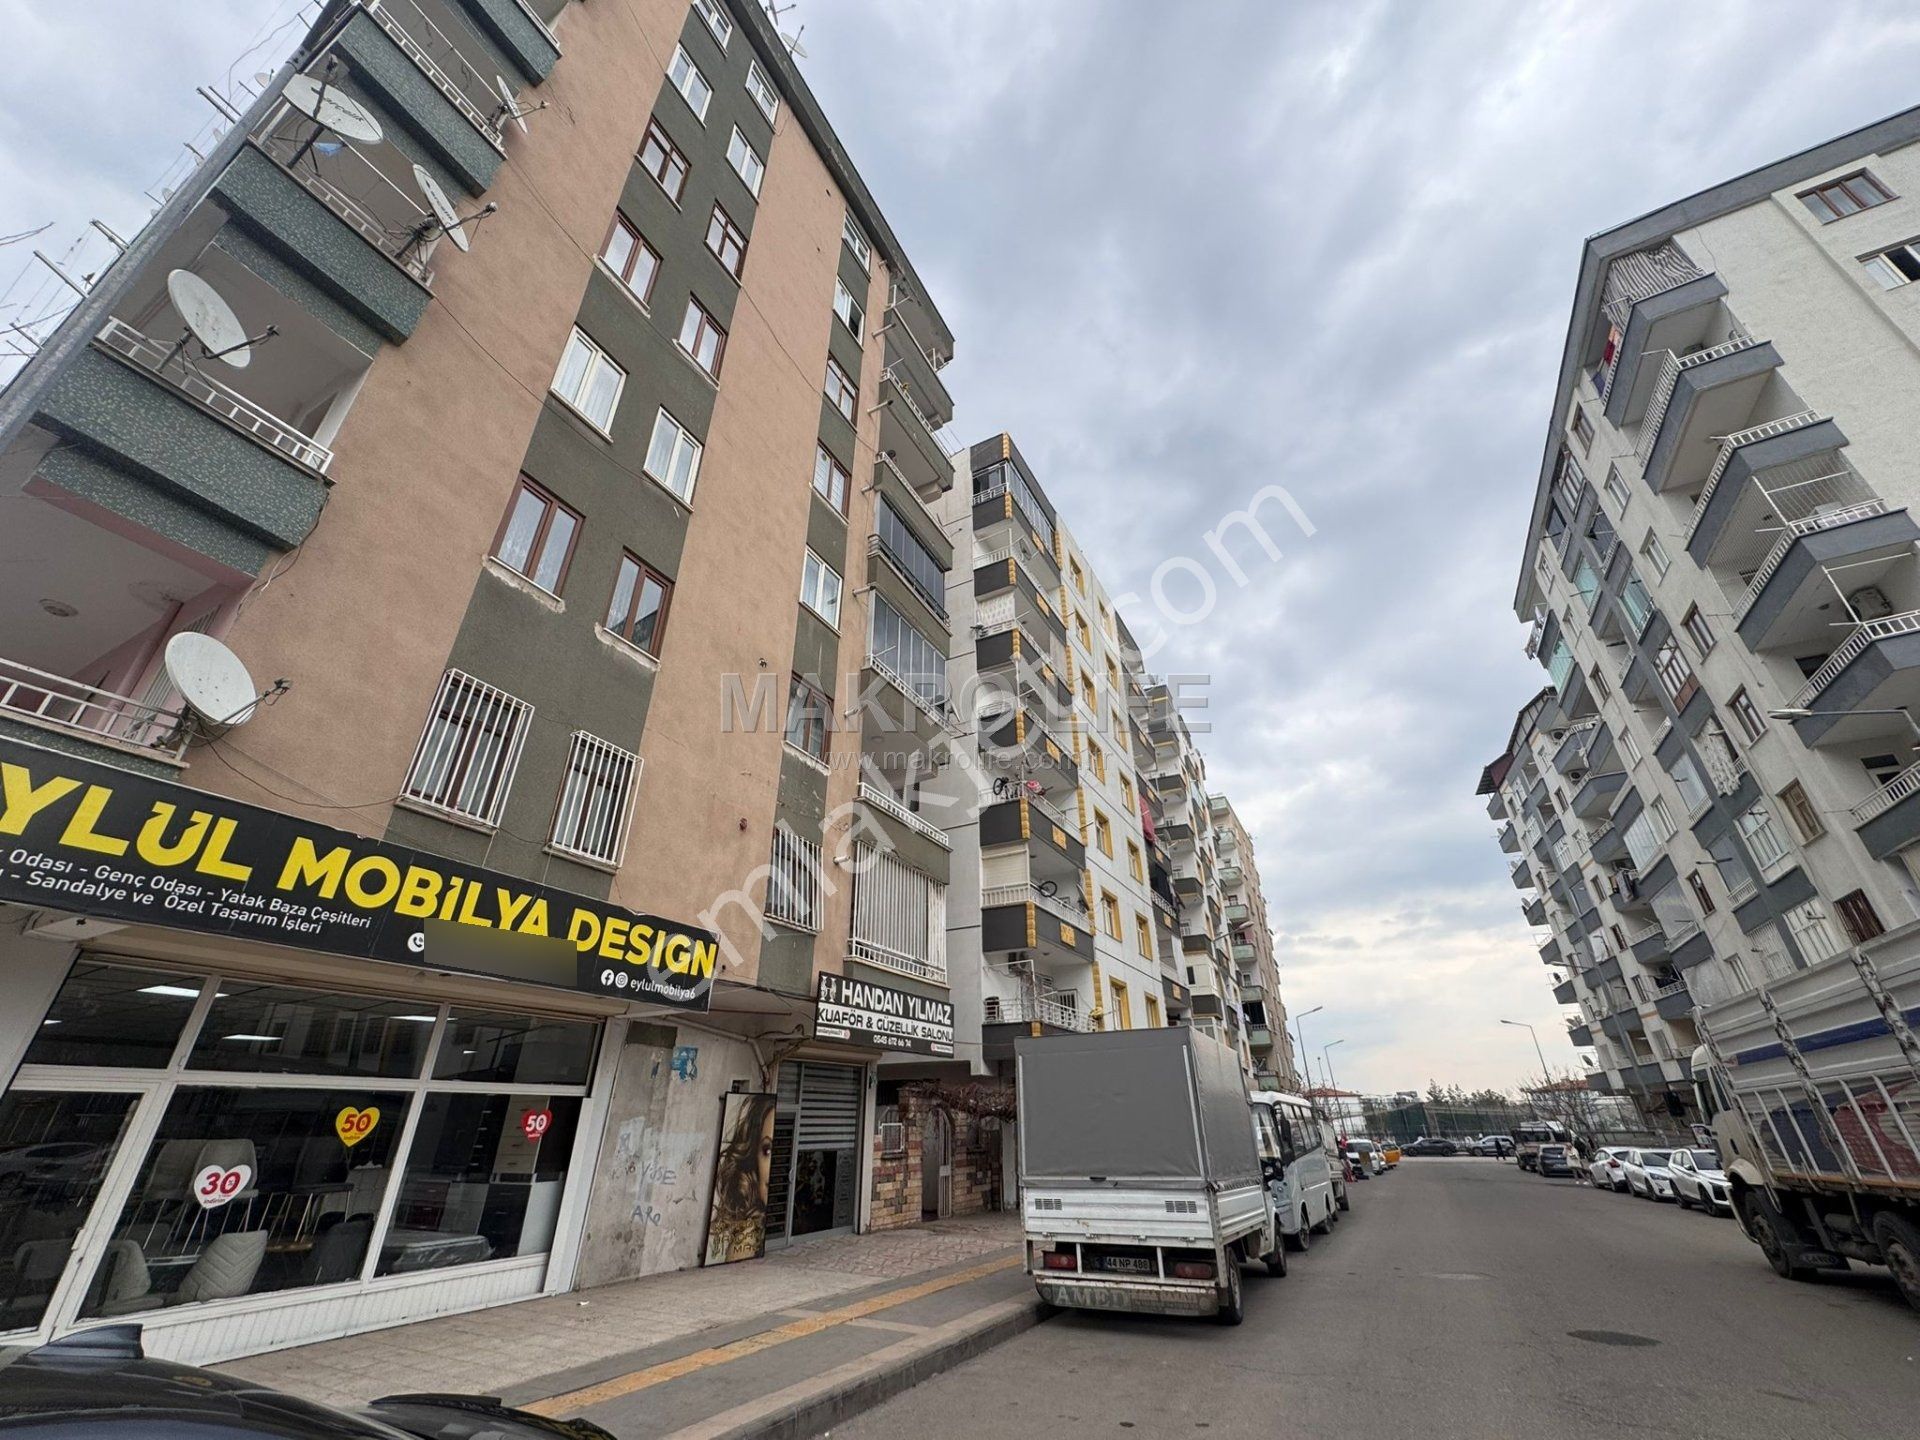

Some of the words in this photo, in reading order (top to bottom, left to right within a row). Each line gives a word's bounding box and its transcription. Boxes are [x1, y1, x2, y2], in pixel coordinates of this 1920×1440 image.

[9, 849, 74, 874] Odası
[94, 865, 146, 888] Genç
[150, 875, 203, 897] Odası
[221, 888, 266, 909] Yatak
[269, 898, 308, 916] Baza
[311, 906, 372, 929] Çeşitleri
[26, 871, 127, 900] Sandalye
[132, 892, 154, 905] ve
[164, 890, 205, 914] Özel
[211, 902, 278, 926] Tasarım
[281, 912, 323, 934] İşleri
[568, 908, 717, 979] DESIGN
[841, 980, 903, 1015] HANDAN
[907, 995, 951, 1025] YILMAZ
[817, 1006, 863, 1028] KUAFÖR
[865, 1016, 874, 1029] &
[876, 1015, 919, 1037] GÜZELLİK
[921, 1026, 953, 1043] SALONU
[341, 1113, 372, 1133] 50
[525, 1114, 547, 1132] 50
[201, 1171, 241, 1195] 30
